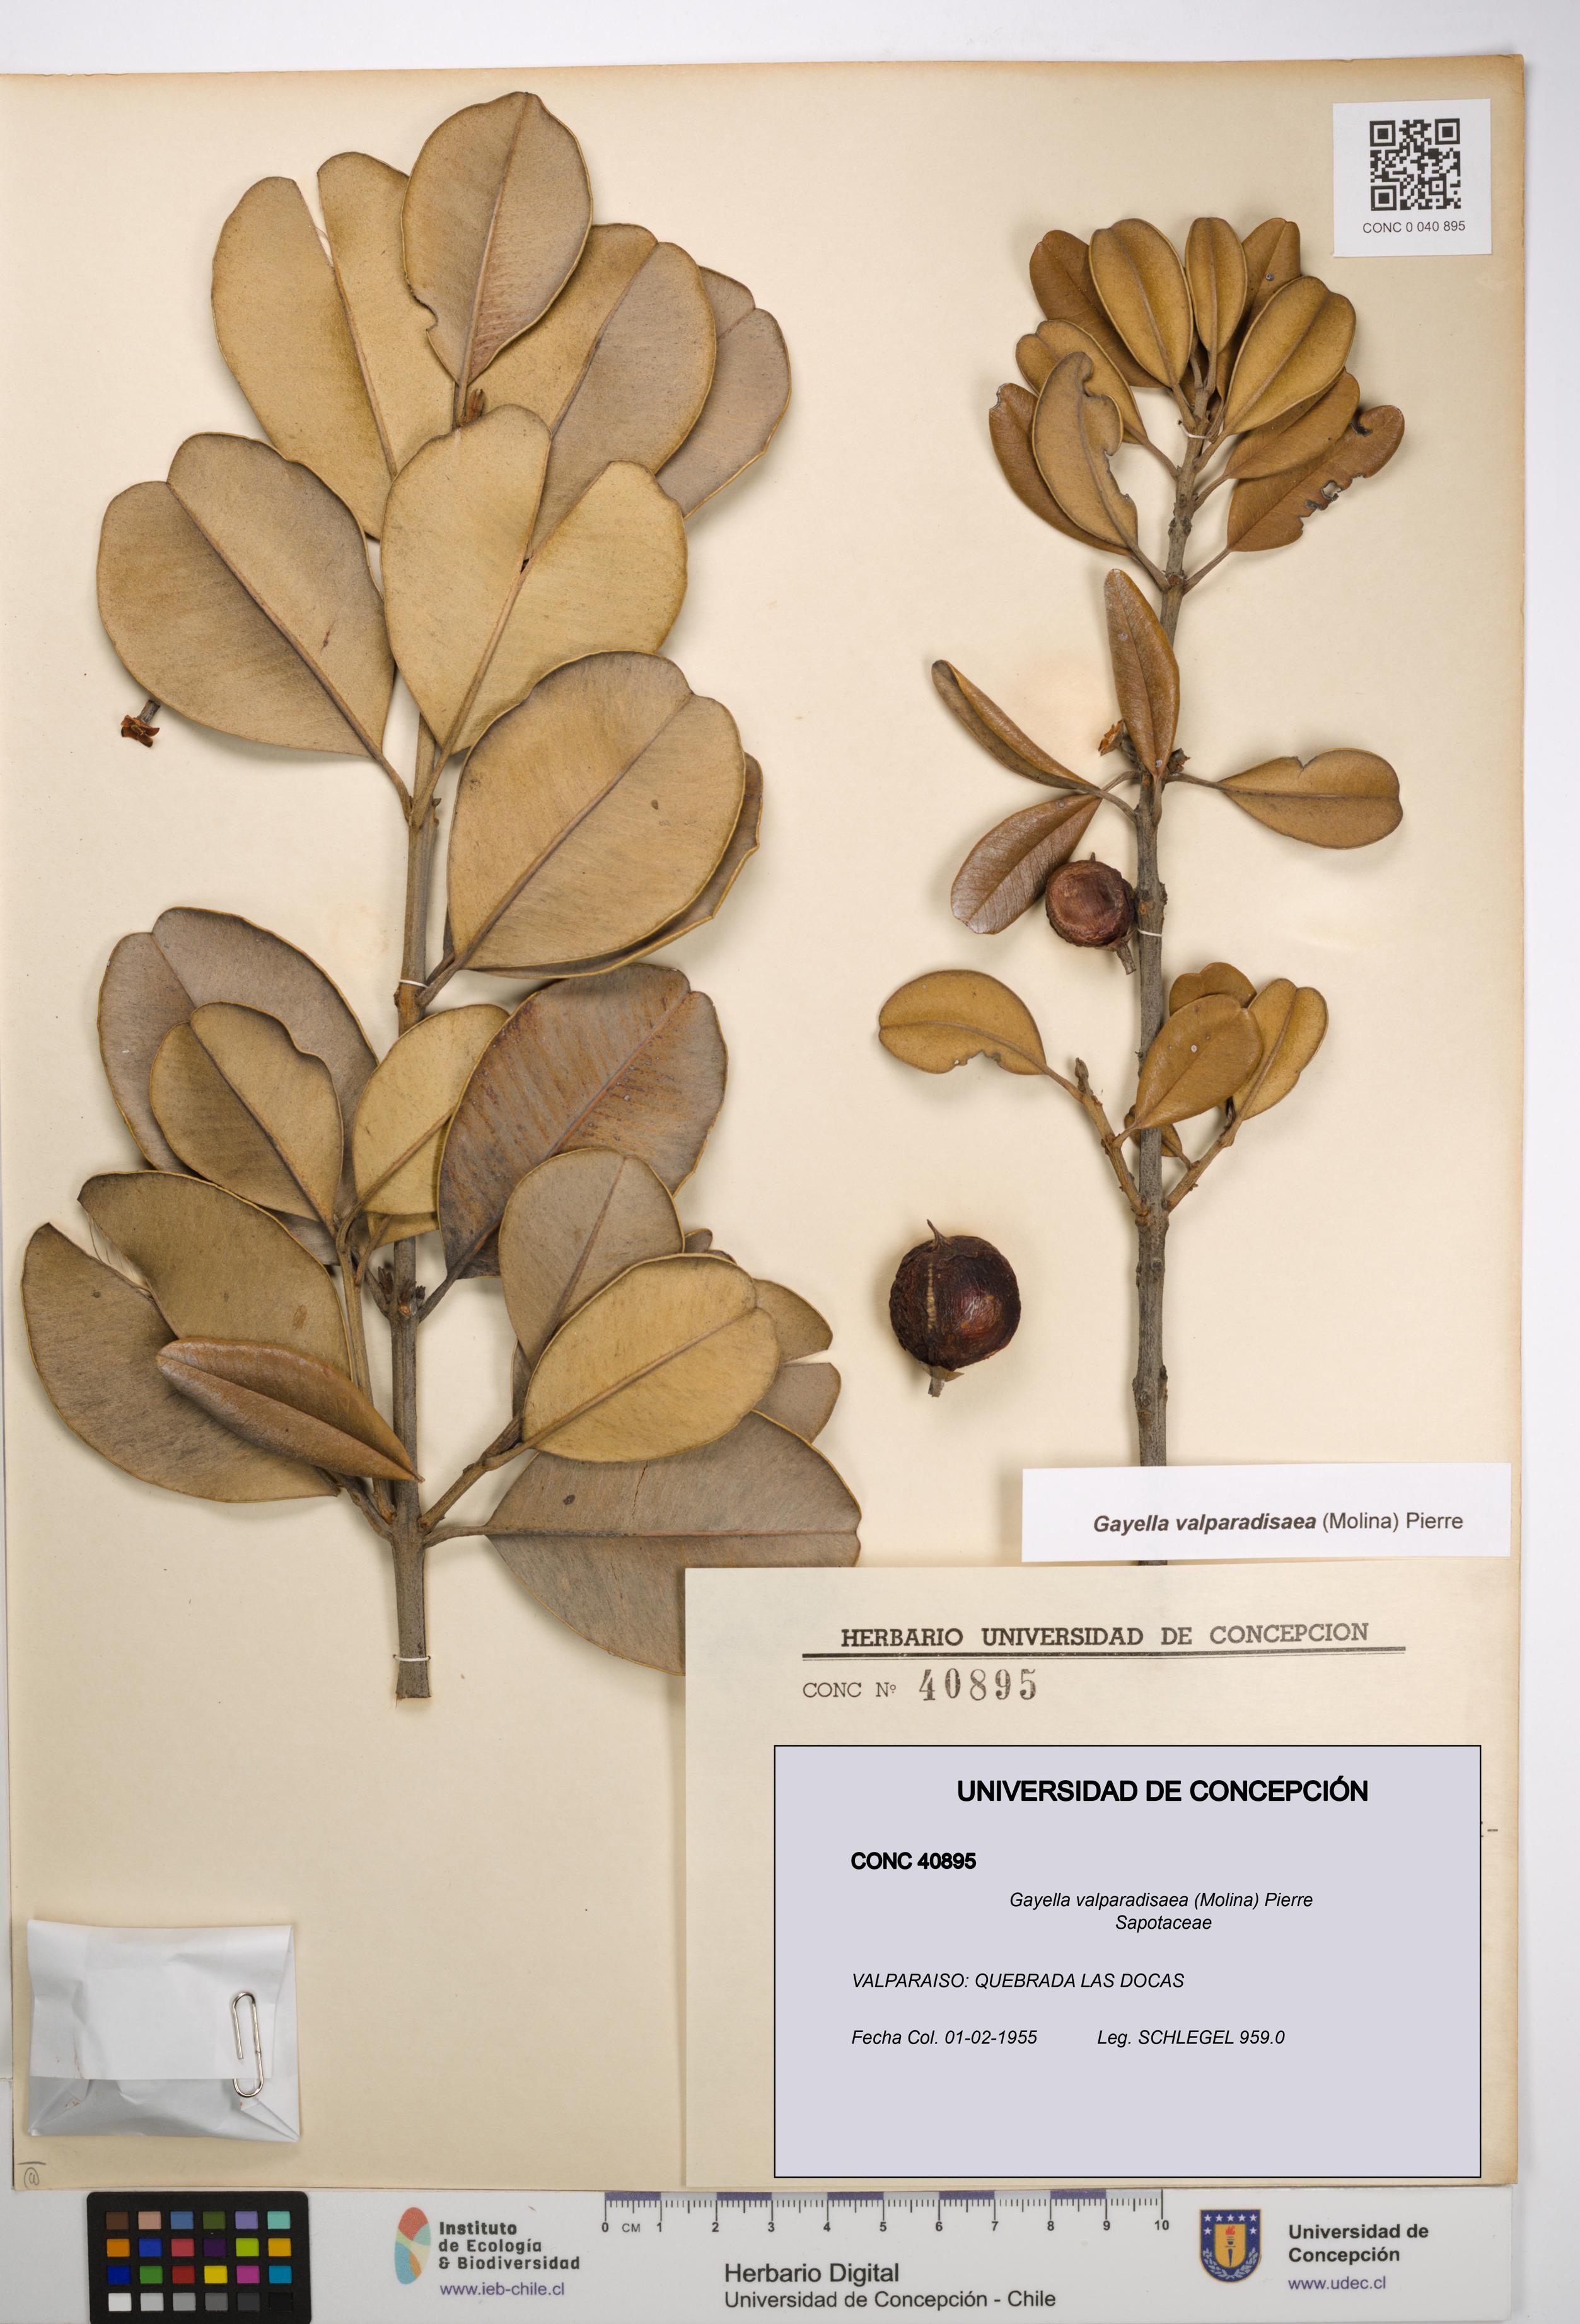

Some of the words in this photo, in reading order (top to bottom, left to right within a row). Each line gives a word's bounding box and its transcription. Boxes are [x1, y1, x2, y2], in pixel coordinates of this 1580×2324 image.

[1363, 223, 1402, 233] CONC
[1406, 222, 1412, 232] 0
[1417, 221, 1439, 232] 040
[1444, 221, 1465, 231] 895
[1094, 1515, 1169, 1536] Gayella
[1176, 1513, 1316, 1534] valparadisaea
[1323, 1512, 1398, 1533] (Molina)
[1407, 1512, 1463, 1529] Pierre
[841, 1628, 963, 1647] HERBARIO
[982, 1627, 1143, 1646] UNIVERSIDAD
[1161, 1627, 1192, 1645] DE
[1211, 1623, 1369, 1643] CONCEPCION
[803, 1682, 861, 1697] CONC
[919, 1668, 1036, 1701] 40895
[440, 2221, 516, 2234] Instituto
[601, 2223, 608, 2232] 0
[622, 2223, 640, 2233] CM
[657, 2223, 662, 2232] 1
[712, 2223, 719, 2232] 2
[768, 2223, 774, 2232] 3
[823, 2222, 830, 2232] 4
[880, 2222, 886, 2231] 5
[936, 2222, 943, 2231] 6
[992, 2221, 998, 2231] 7
[1047, 2221, 1054, 2231] 8
[1103, 2221, 1110, 2231] 9
[1155, 2221, 1169, 2230] 10
[1289, 2224, 1400, 2239] Universidad
[1407, 2224, 1428, 2238] de
[439, 2239, 458, 2252] de
[467, 2239, 541, 2254] Ecología
[439, 2257, 450, 2269] &
[458, 2256, 579, 2269] Biodiversidad
[1289, 2247, 1399, 2265] Concepción
[726, 2263, 821, 2282] Herbario
[830, 2263, 898, 2287] Digital
[1288, 2276, 1385, 2289] www.udec.cl
[440, 2282, 564, 2295] www.ieb-chile.cl
[726, 2292, 837, 2308] Universidad
[845, 2291, 867, 2307] de
[875, 2291, 987, 2311] Concepción
[1008, 2291, 1055, 2306] Chile
